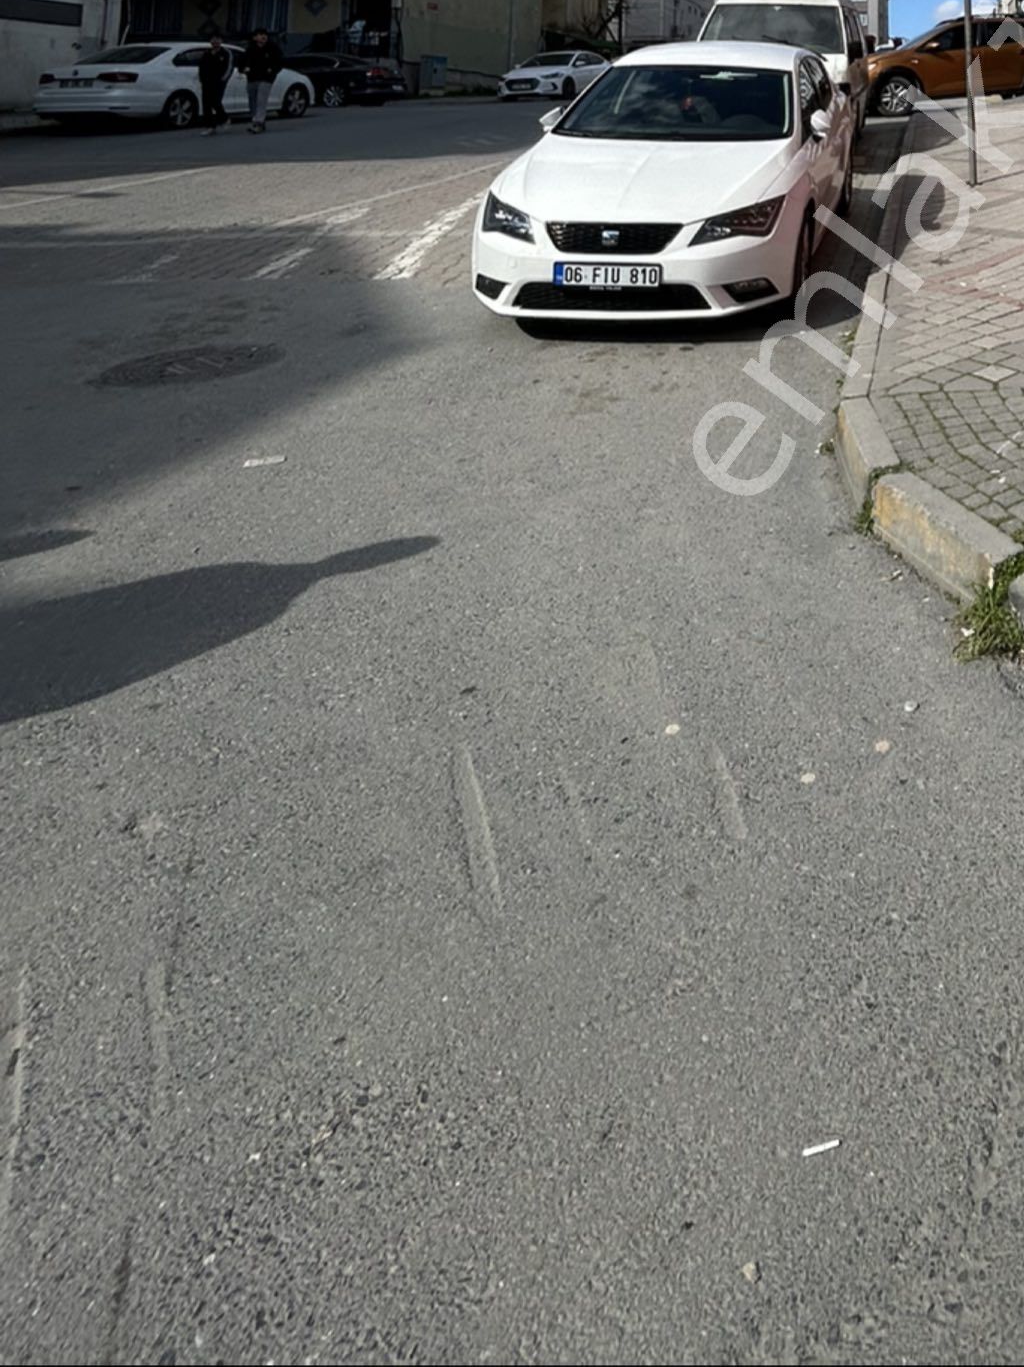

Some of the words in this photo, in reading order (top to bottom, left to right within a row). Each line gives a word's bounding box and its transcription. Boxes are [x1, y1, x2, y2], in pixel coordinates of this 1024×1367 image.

[565, 266, 583, 284] 06
[592, 267, 620, 284] FIU
[630, 267, 658, 285] 810
